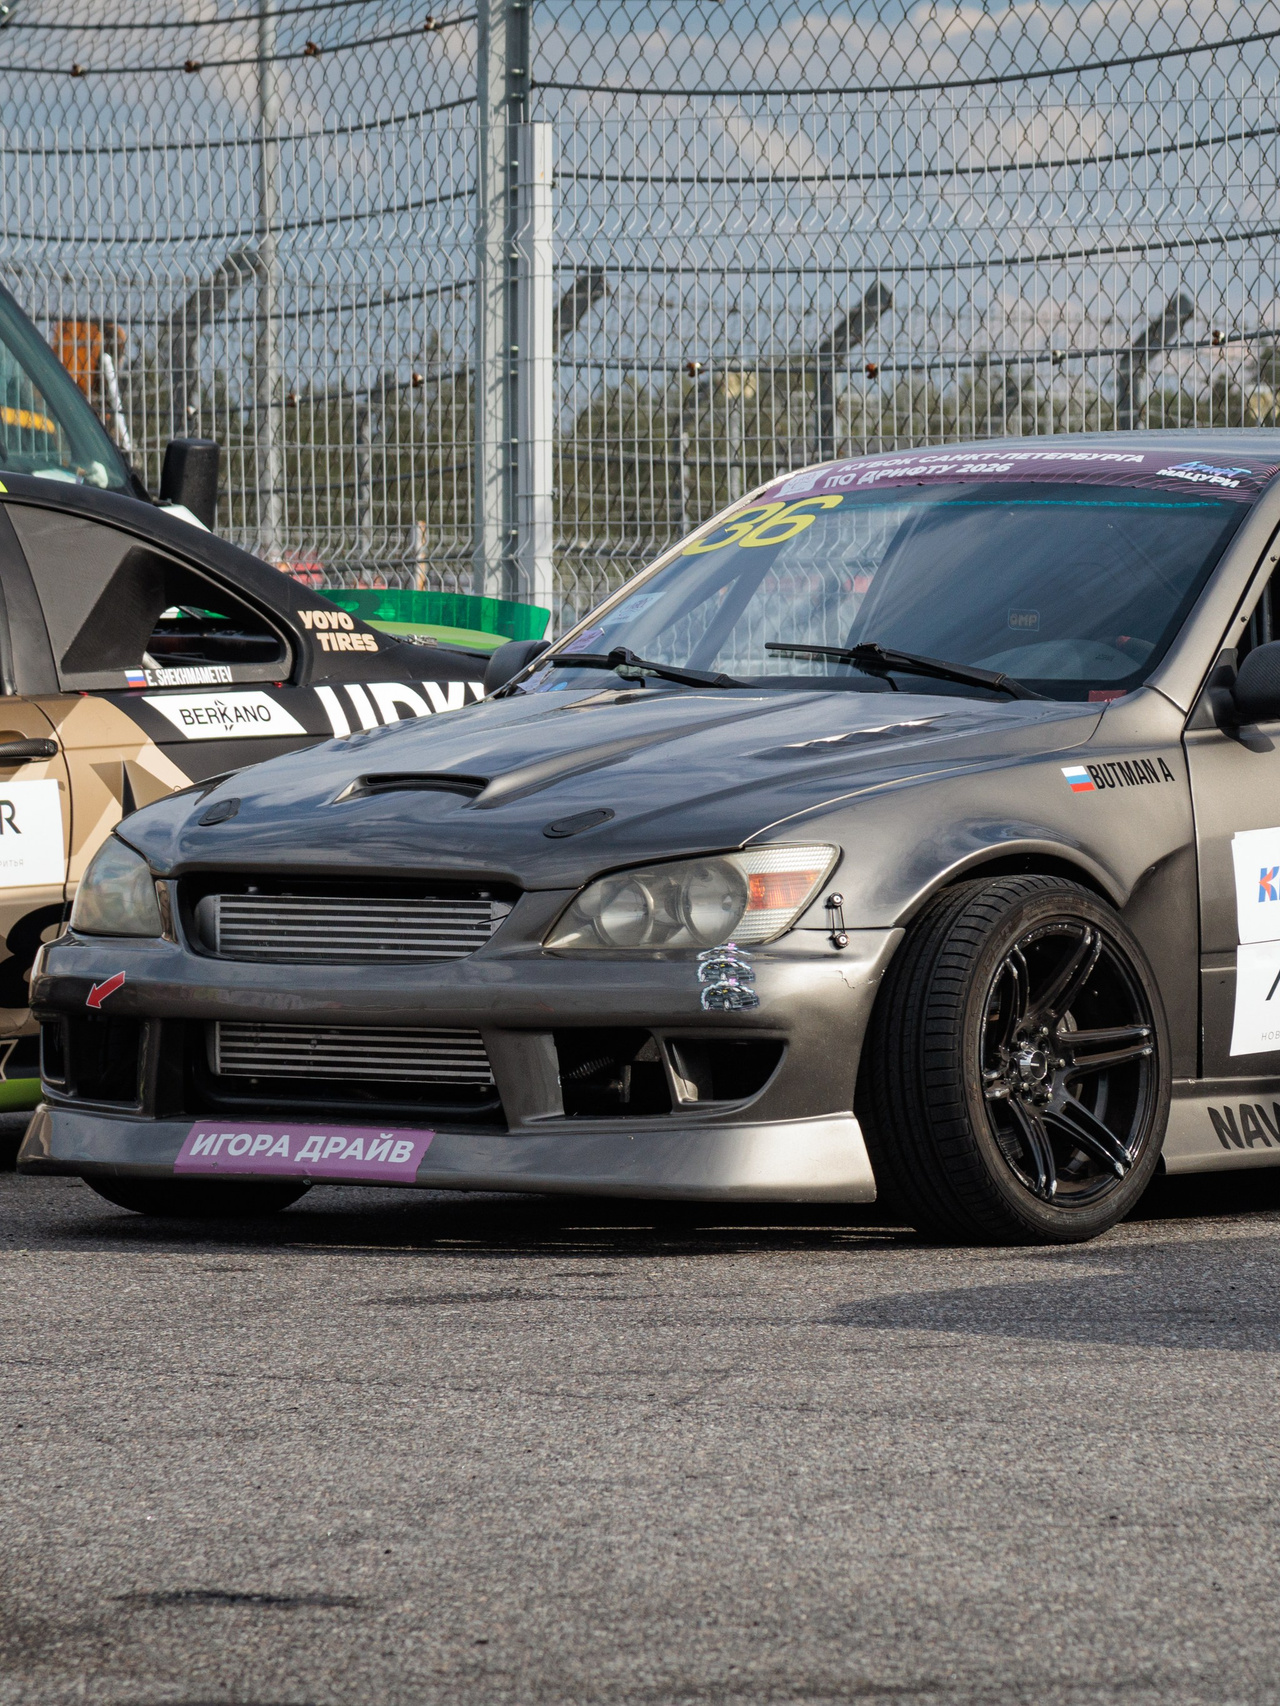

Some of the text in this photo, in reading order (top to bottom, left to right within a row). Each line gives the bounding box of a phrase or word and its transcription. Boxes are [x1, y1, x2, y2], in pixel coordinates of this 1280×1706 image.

[837, 452, 1144, 472] КУБОК САНКТ-ПЕТЕРБУРГА
[823, 475, 854, 489] ПО
[857, 464, 954, 485] ДРИФТУ
[956, 463, 1014, 473] 2026
[1155, 469, 1240, 488] МАЦУРИ
[682, 495, 843, 555] 36
[297, 610, 354, 630] YOYO
[316, 632, 379, 652] TIRES
[157, 665, 233, 685] SHEKHMAMETEV
[179, 702, 272, 728] BERKANO
[1087, 757, 1175, 789] BUTMAN A
[189, 1133, 415, 1164] ИГОРА ДРАЙВ
